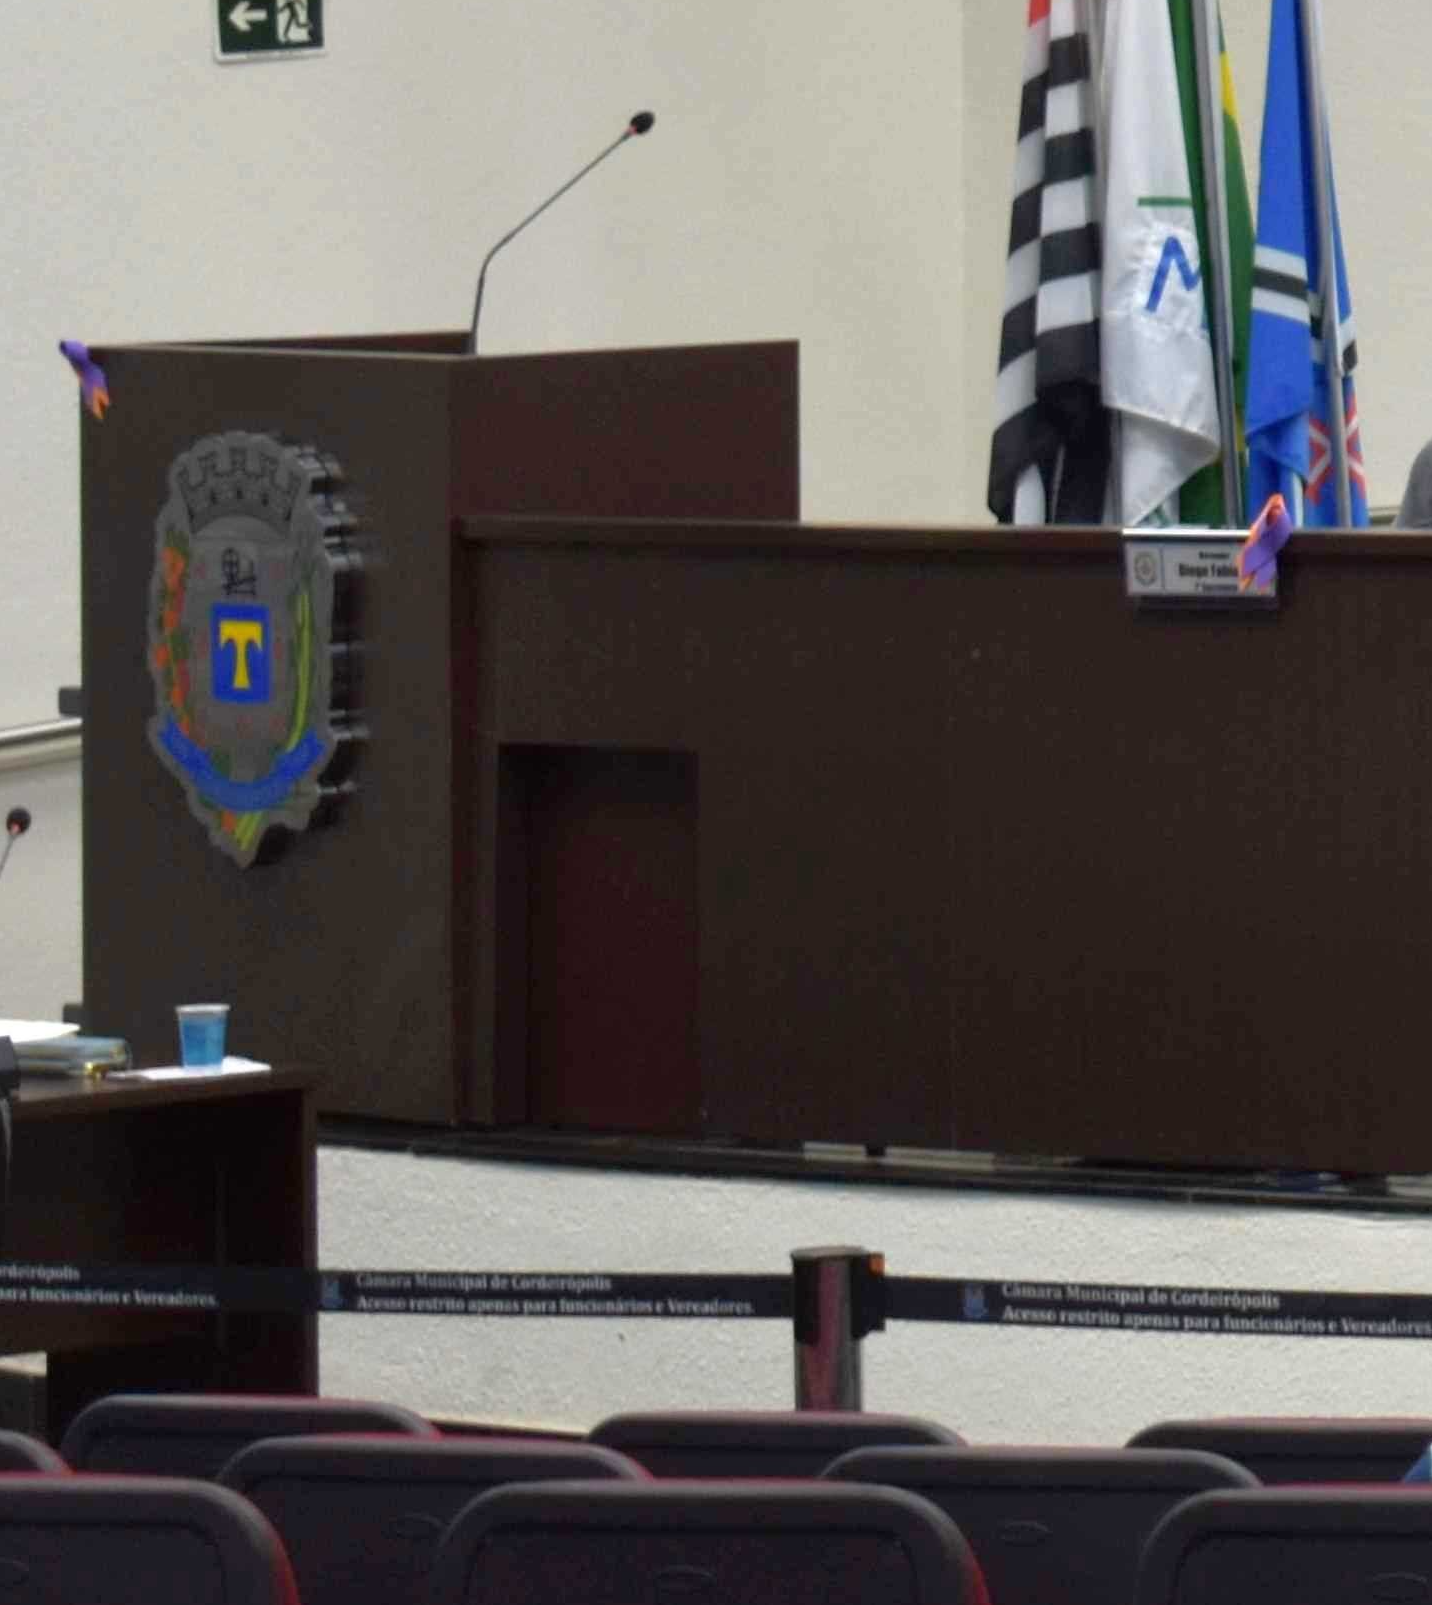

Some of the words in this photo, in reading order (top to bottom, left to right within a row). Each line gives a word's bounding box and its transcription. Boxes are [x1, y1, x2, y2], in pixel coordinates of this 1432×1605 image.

[415, 1274, 488, 1292] Municipal
[490, 1275, 509, 1290] de
[409, 1296, 466, 1312] restrito
[523, 1300, 556, 1316] para
[1002, 1281, 1063, 1299] Câmara
[1066, 1283, 1145, 1306] Municipal
[1148, 1289, 1168, 1305] de
[1170, 1289, 1280, 1311] Cordeirópolis
[1002, 1304, 1057, 1322] Acesso
[1060, 1307, 1121, 1326] restrito
[1123, 1311, 1180, 1329] apenas
[1183, 1314, 1220, 1331] para
[1223, 1312, 1325, 1333] funcionários
[1328, 1319, 1337, 1332] e
